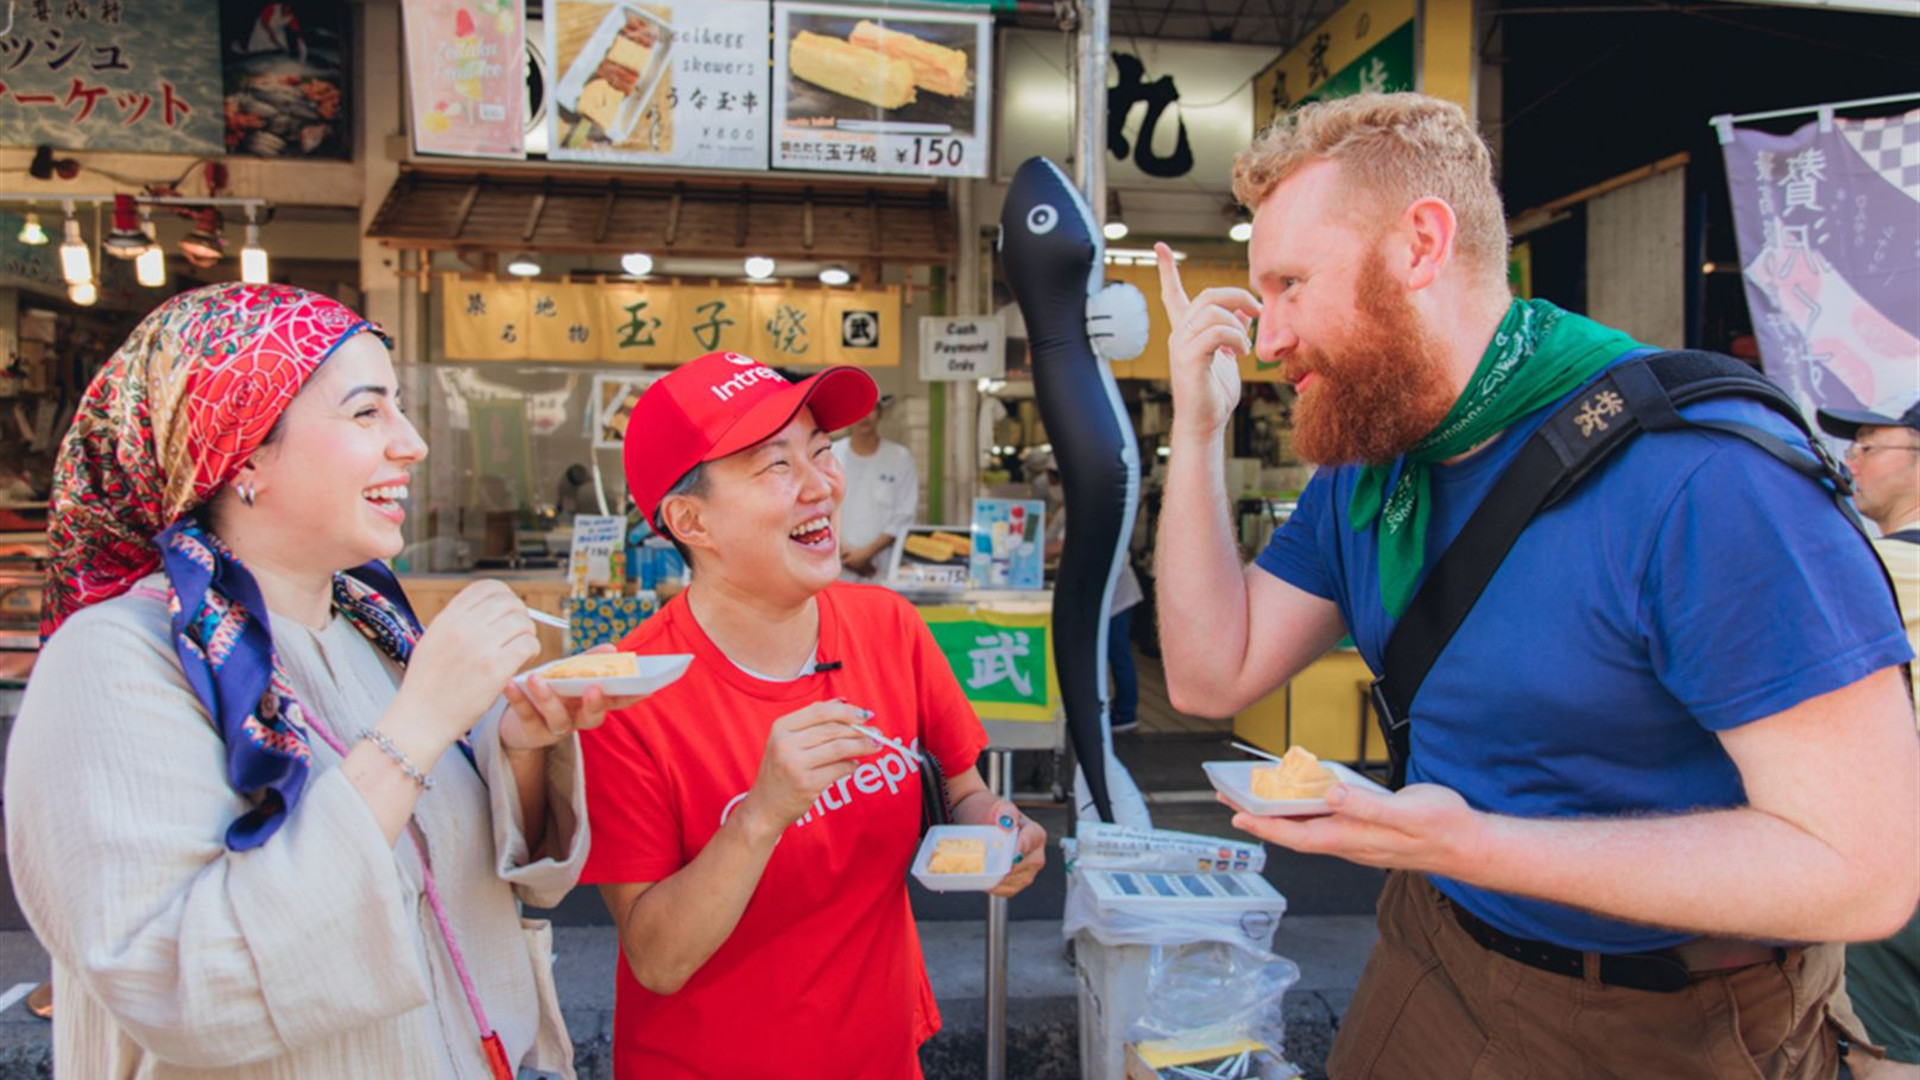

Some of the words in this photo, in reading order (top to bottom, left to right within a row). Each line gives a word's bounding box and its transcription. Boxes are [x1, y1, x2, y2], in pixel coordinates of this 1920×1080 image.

[0, 78, 191, 126] ーケット
[895, 137, 964, 167] ¥150
[946, 323, 978, 335] Cash
[966, 631, 1032, 697] 武
